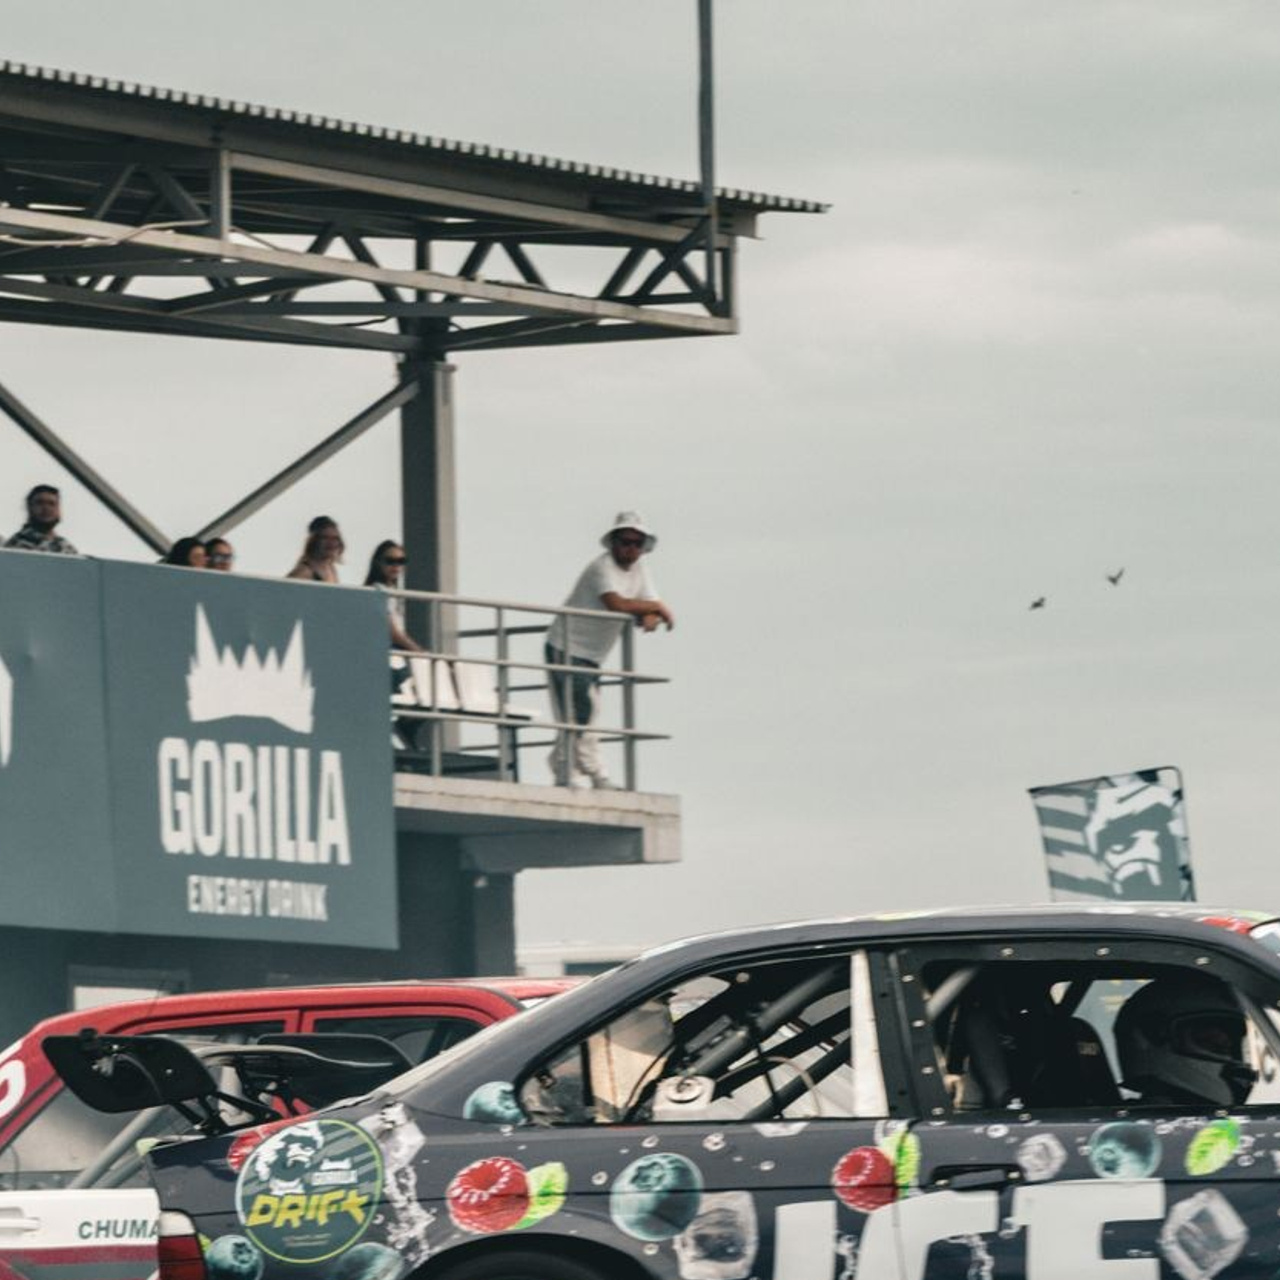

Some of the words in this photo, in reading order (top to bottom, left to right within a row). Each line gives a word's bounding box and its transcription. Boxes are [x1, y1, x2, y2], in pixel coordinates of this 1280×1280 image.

[158, 737, 351, 866] GORILLA
[187, 874, 264, 917] ENERGY
[267, 878, 328, 921] DRINK
